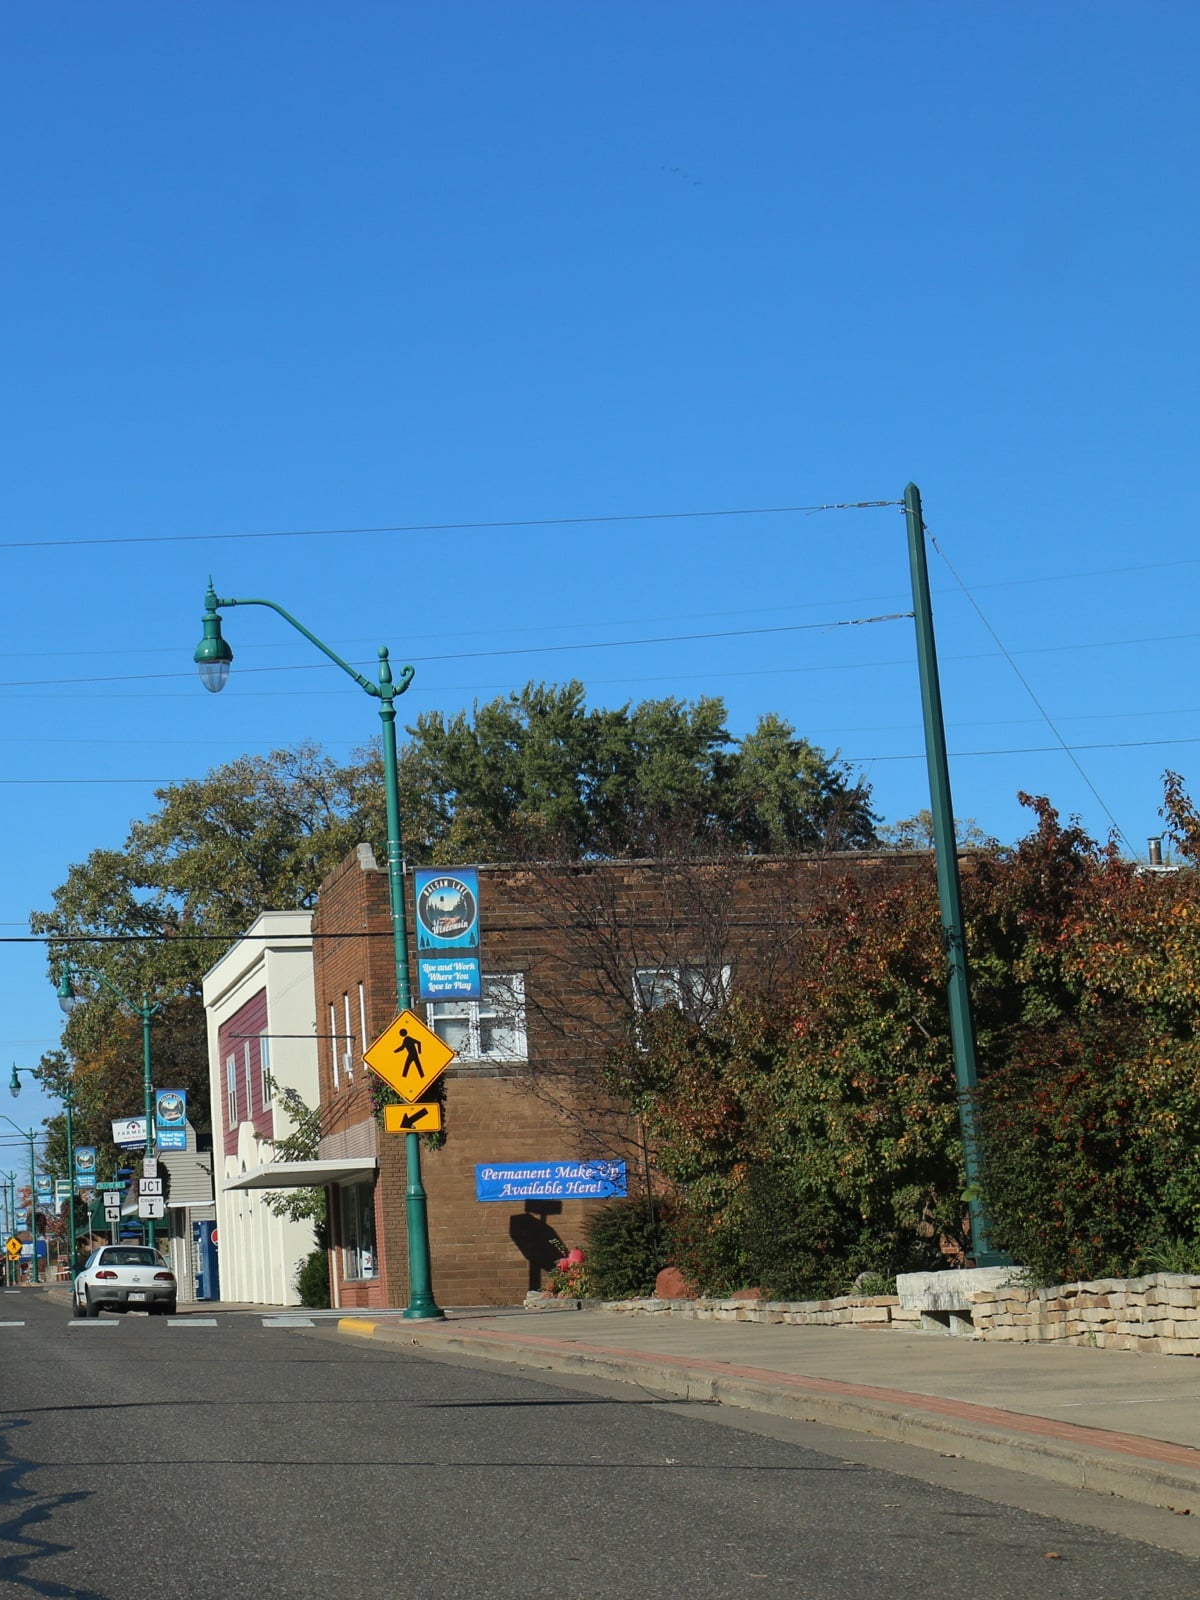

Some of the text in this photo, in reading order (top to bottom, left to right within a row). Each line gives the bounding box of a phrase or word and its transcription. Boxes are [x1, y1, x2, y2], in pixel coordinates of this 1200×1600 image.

[452, 881, 469, 896] LAKE
[431, 919, 469, 935] Wisconsin
[422, 962, 475, 973] Live and Work
[428, 971, 469, 981] Where You
[444, 982, 453, 990] to
[453, 981, 472, 991] Play
[117, 1129, 147, 1137] FARMER
[481, 1163, 620, 1181] Permanent Make-Up
[141, 1181, 161, 1192] JCT
[499, 1181, 602, 1197] Available Here!
[148, 1203, 155, 1215] I
